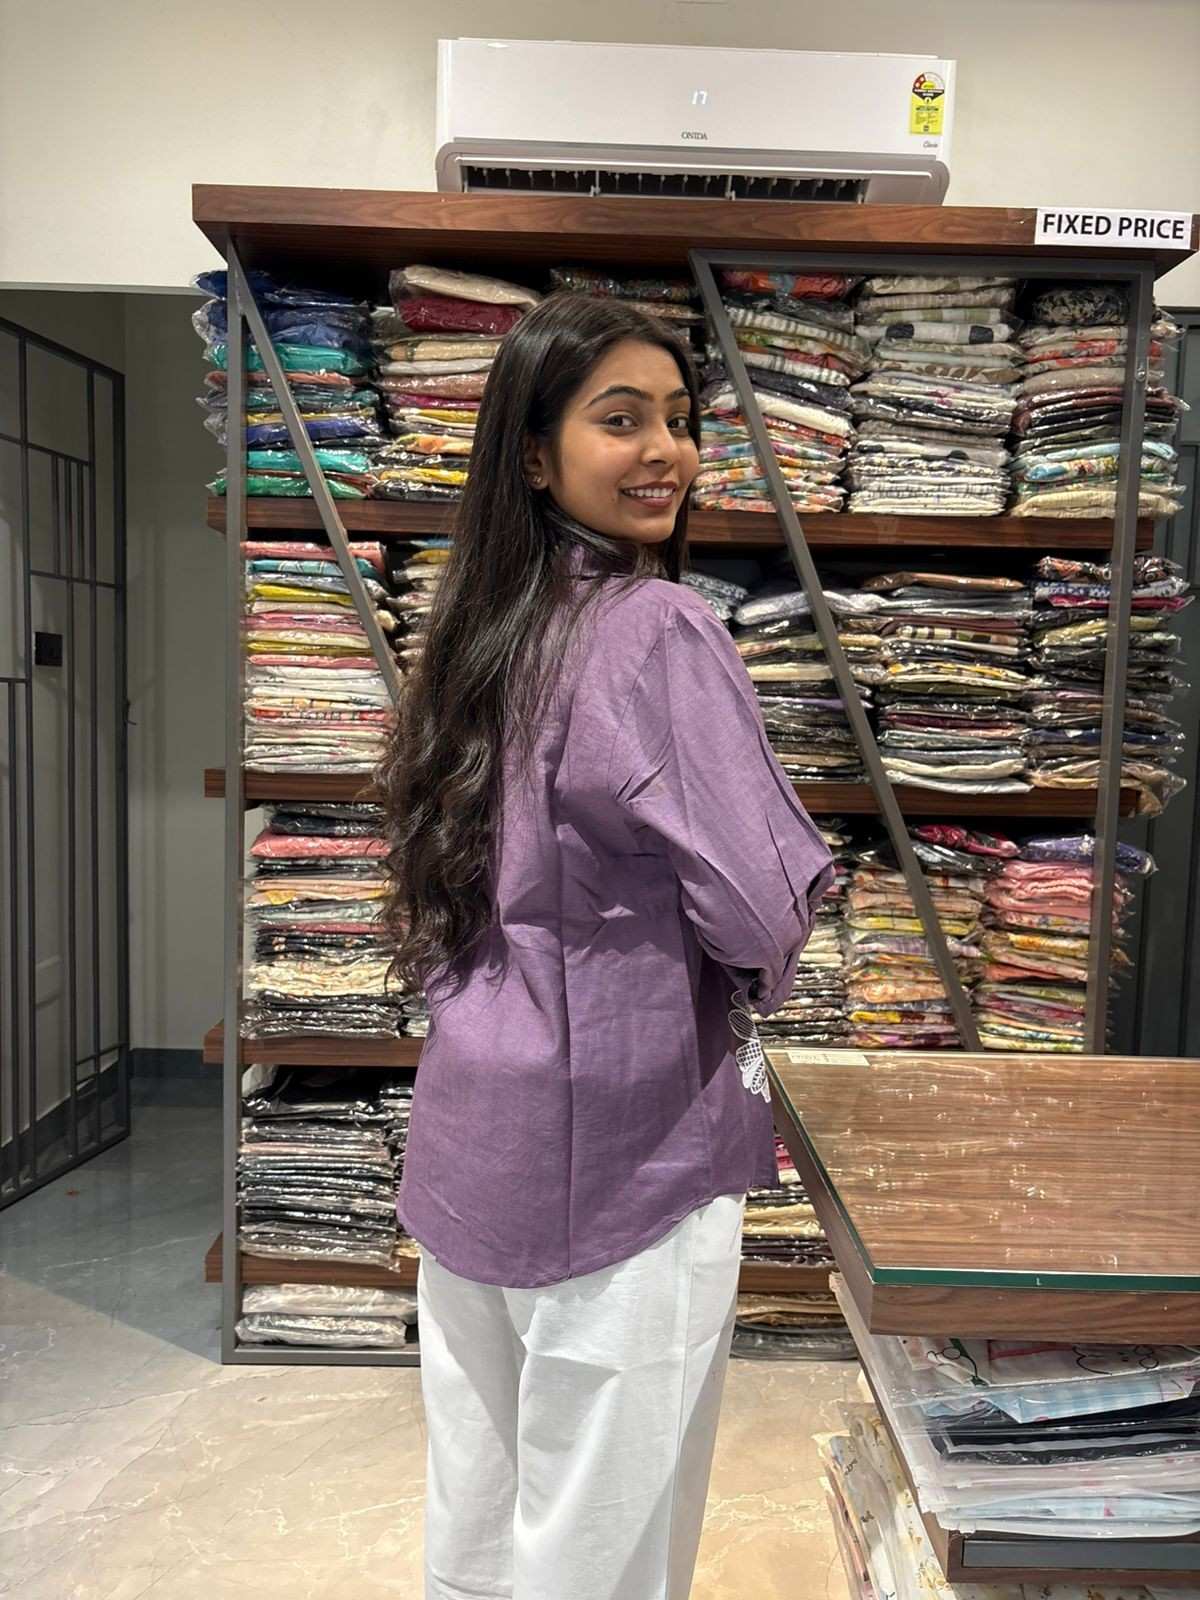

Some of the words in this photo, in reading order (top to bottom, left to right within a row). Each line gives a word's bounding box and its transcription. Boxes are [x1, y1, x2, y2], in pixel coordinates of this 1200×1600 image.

[681, 131, 708, 141] ONIDA
[1042, 213, 1112, 236] FIXED
[1118, 217, 1185, 240] PRICE
